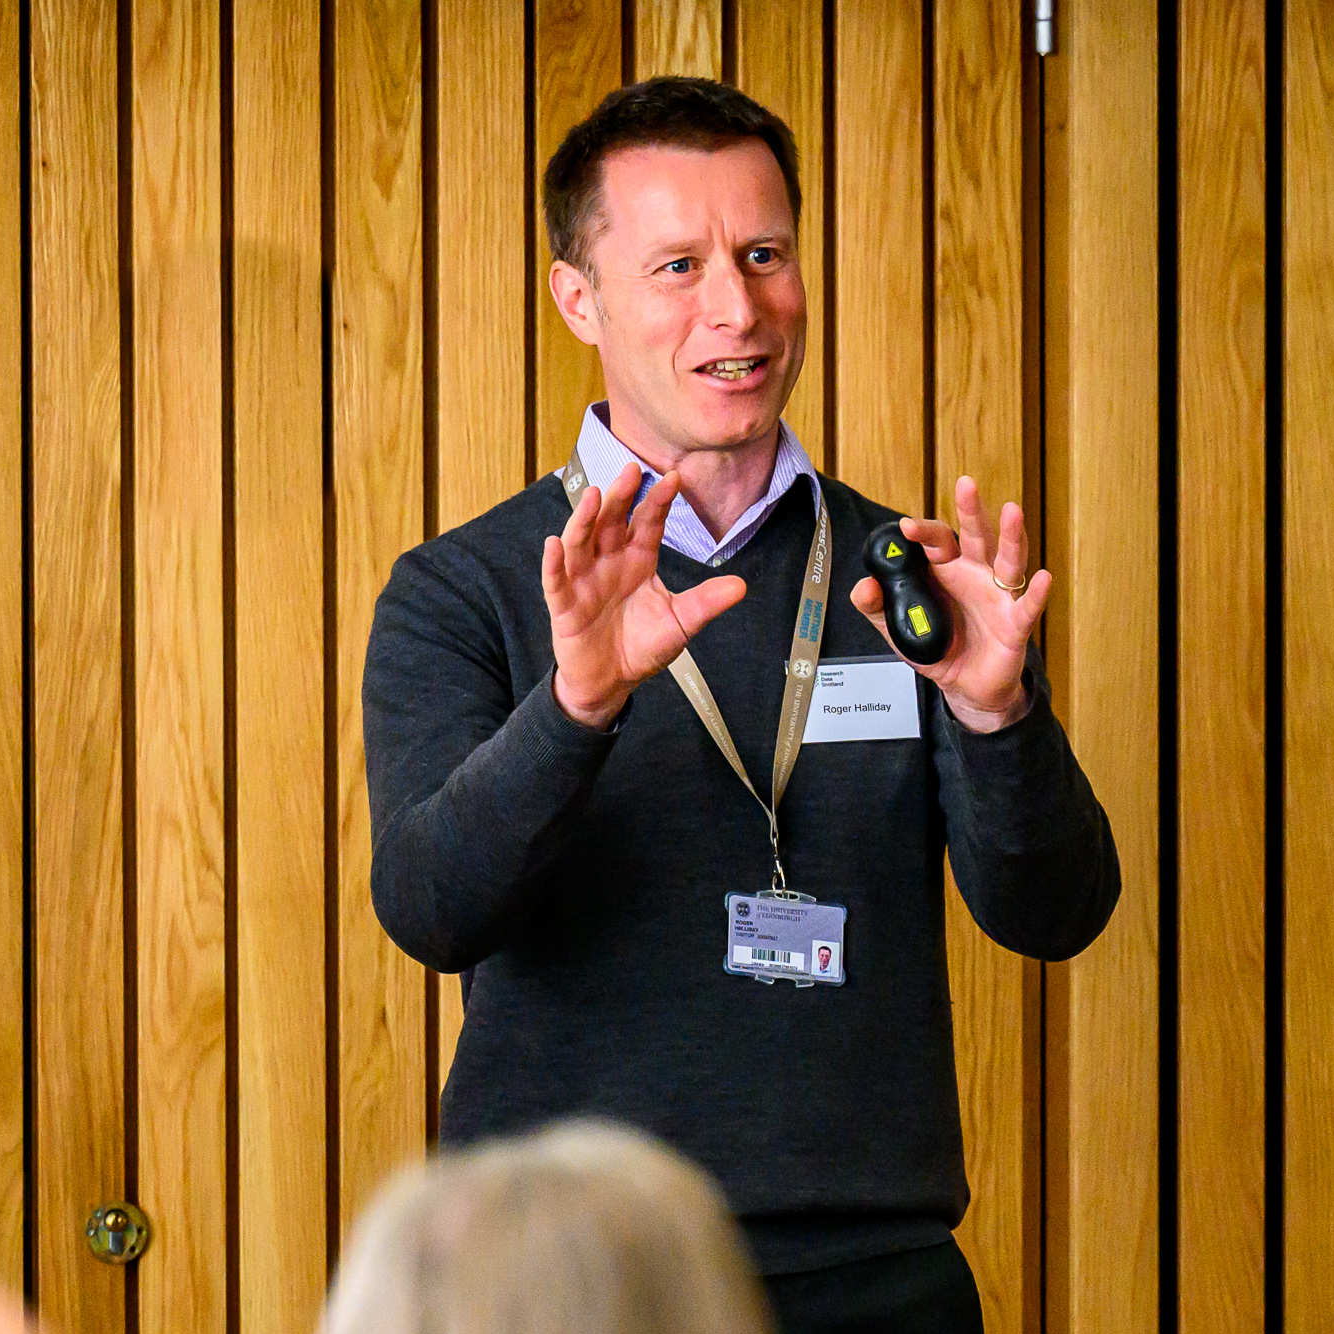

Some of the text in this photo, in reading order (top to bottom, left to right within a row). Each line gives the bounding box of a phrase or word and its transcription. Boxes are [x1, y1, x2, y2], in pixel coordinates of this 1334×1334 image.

[799, 598, 813, 639] MEMBER
[809, 600, 823, 642] PARTNER
[823, 702, 891, 715] Roger Halliday
[770, 906, 809, 917] UNIVERSITY
